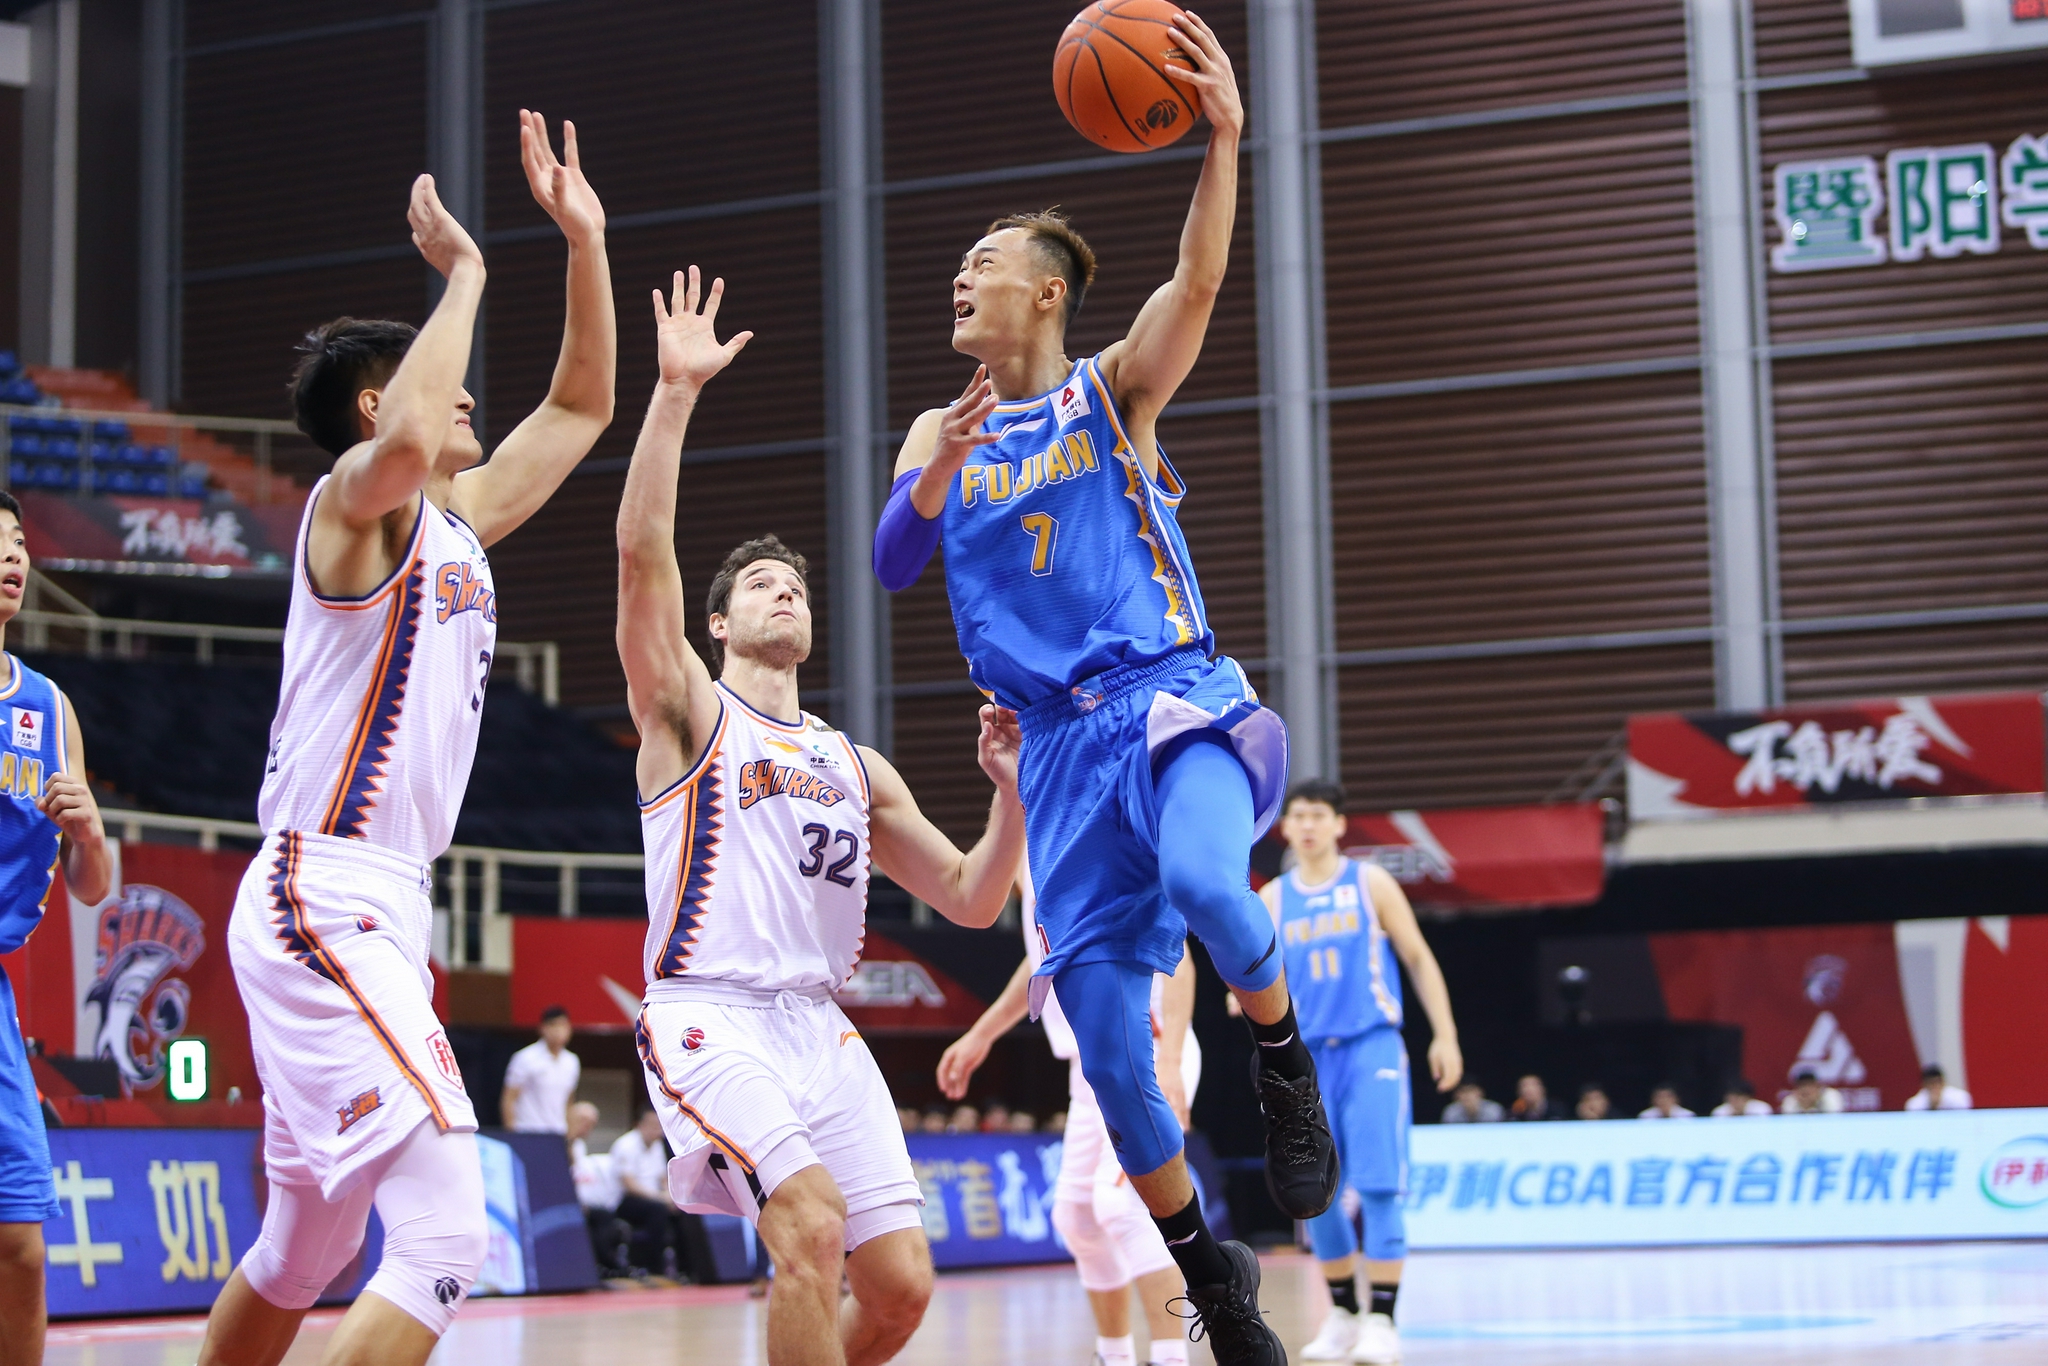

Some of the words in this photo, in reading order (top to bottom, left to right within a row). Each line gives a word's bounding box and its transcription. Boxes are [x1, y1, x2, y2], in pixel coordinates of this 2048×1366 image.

[961, 429, 1101, 509] FUJIAN
[1020, 511, 1059, 577] 7
[739, 759, 846, 810] SHARKS
[800, 822, 859, 888] 32
[1285, 911, 1360, 946] FUJIAN
[1310, 949, 1341, 980] 11
[169, 1039, 207, 1100] 0
[336, 1085, 385, 1136] 上海
[48, 1160, 232, 1287] 牛奶
